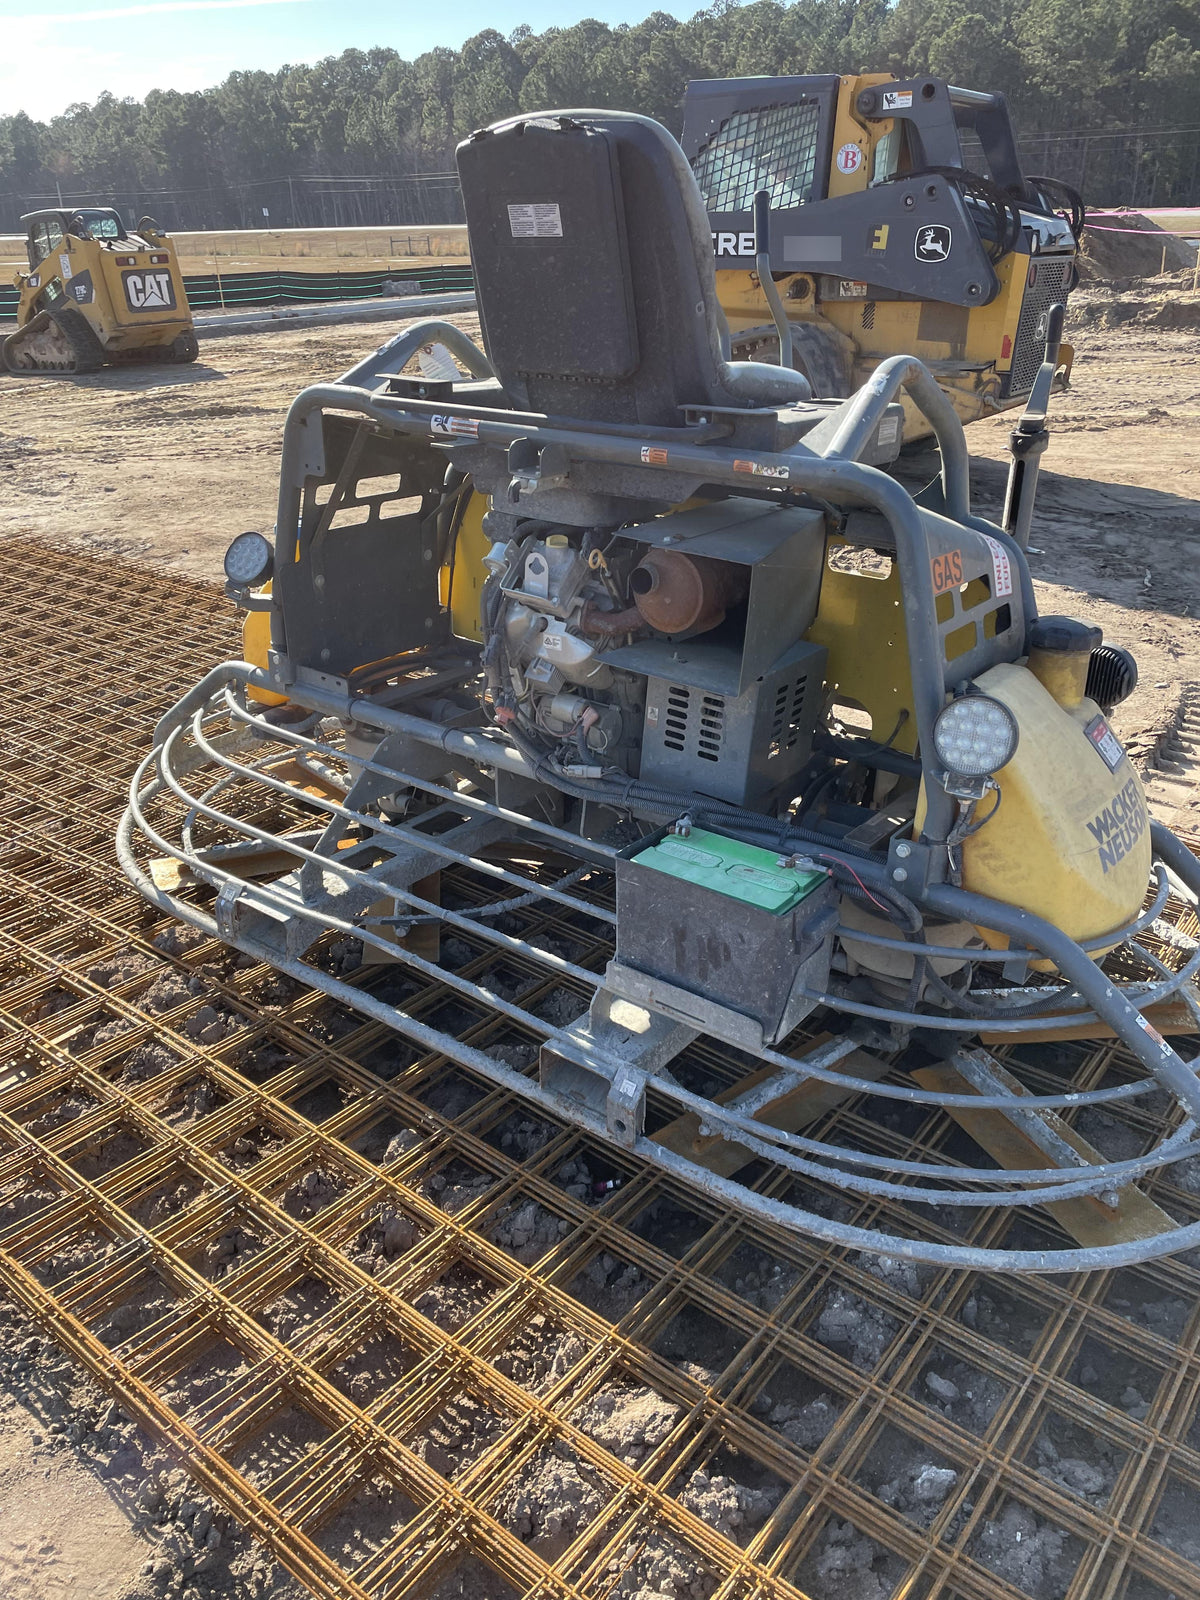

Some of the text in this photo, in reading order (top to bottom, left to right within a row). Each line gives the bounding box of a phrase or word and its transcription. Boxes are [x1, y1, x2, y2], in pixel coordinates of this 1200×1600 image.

[843, 150, 857, 169] B
[126, 273, 171, 309] CAT
[932, 551, 963, 591] GAS
[1086, 777, 1142, 845] WACKER
